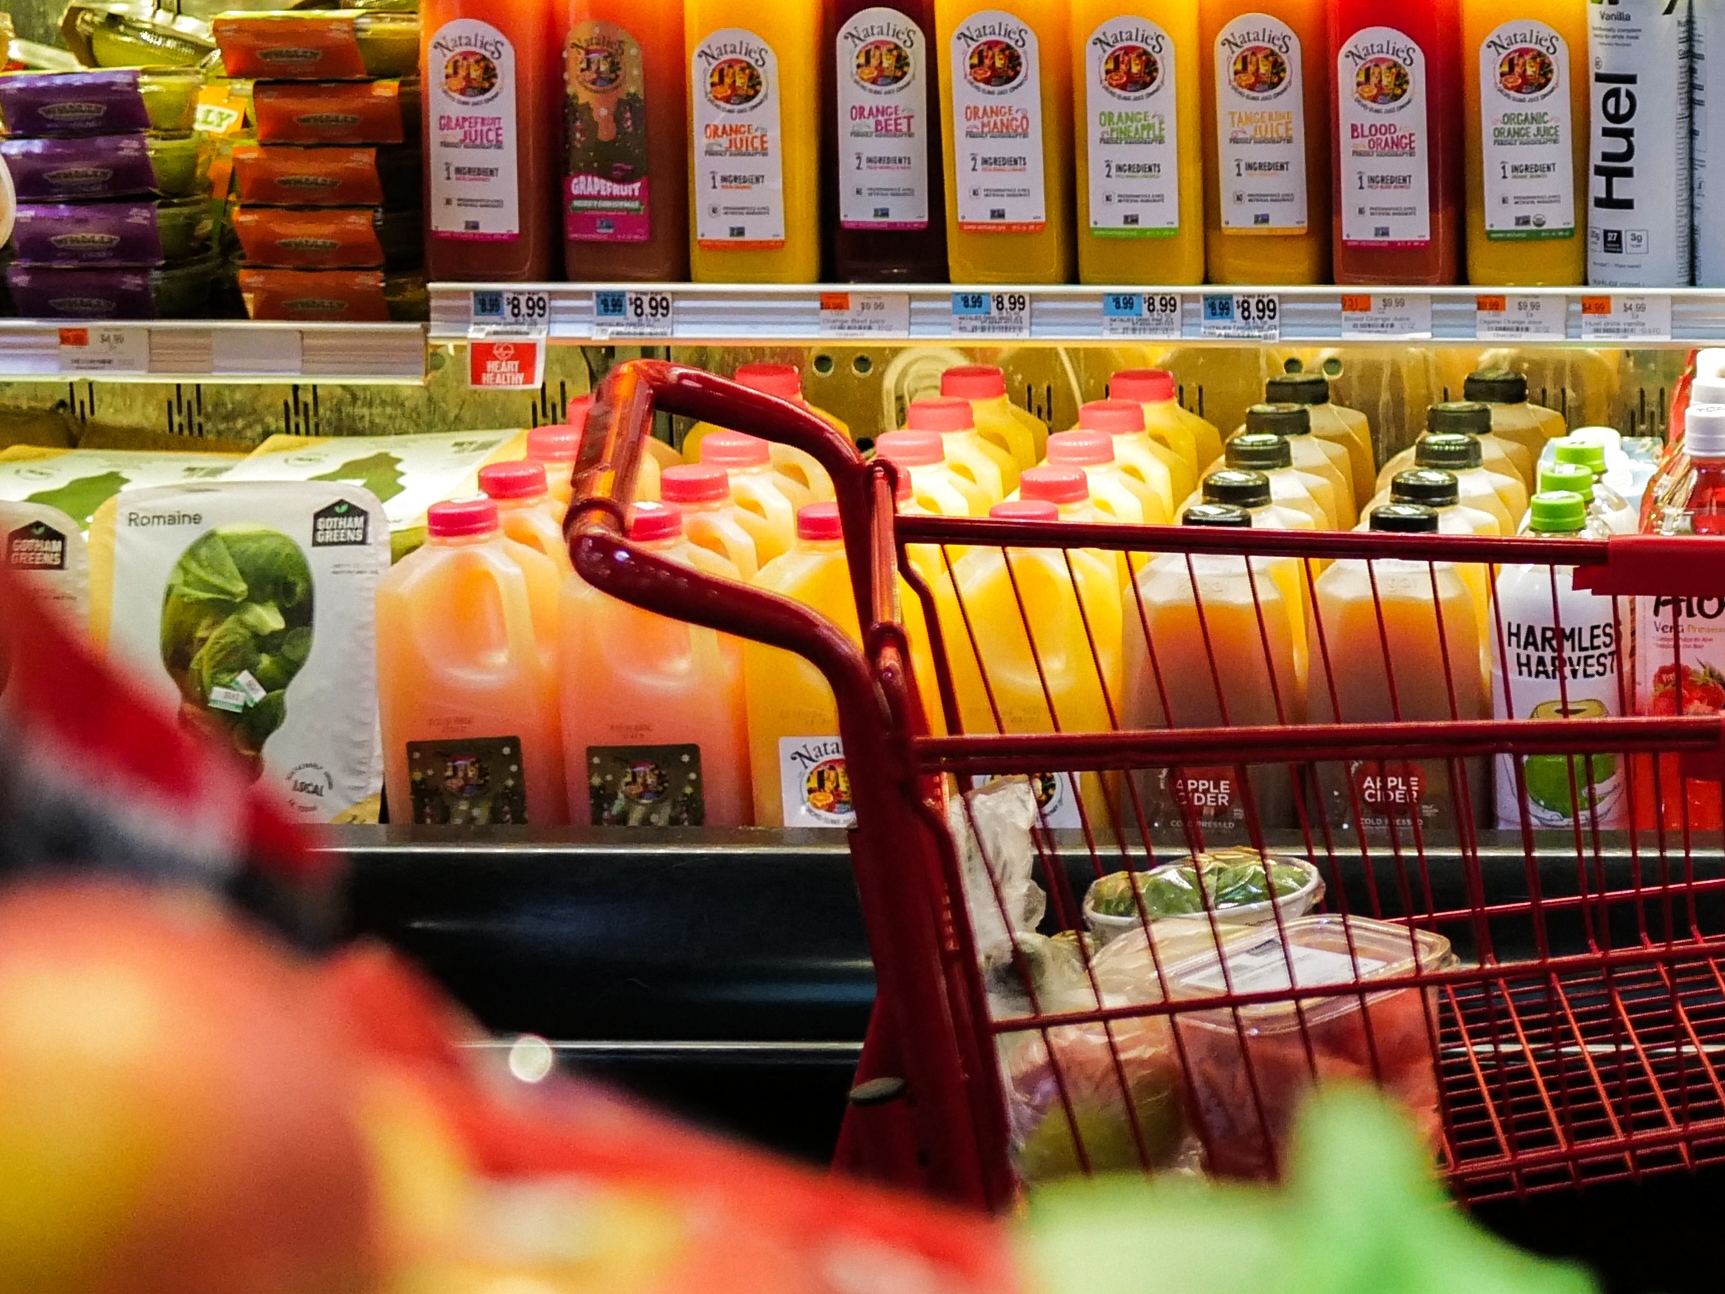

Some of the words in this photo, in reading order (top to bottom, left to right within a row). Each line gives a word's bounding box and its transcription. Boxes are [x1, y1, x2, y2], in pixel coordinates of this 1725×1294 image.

[965, 106, 1014, 122] ORANGE
[1502, 112, 1549, 127] ORGANIC
[875, 117, 915, 134] BEET
[980, 117, 1029, 133] MANGO
[1350, 123, 1397, 140] BLOOD
[1493, 126, 1531, 138] ORANGE
[1533, 125, 1560, 137] JUICE
[1367, 133, 1416, 150] ORANGE
[1593, 70, 1637, 210] Huel
[866, 156, 912, 167] INGREDIENTS
[571, 181, 642, 197] GRAPEFRUIT
[507, 296, 547, 320] $8.99
[486, 360, 519, 373] HEART
[481, 372, 525, 386] HEALTHY
[127, 512, 203, 526] Romaine
[316, 518, 365, 532] GOTHAM
[317, 529, 365, 543] GREENS
